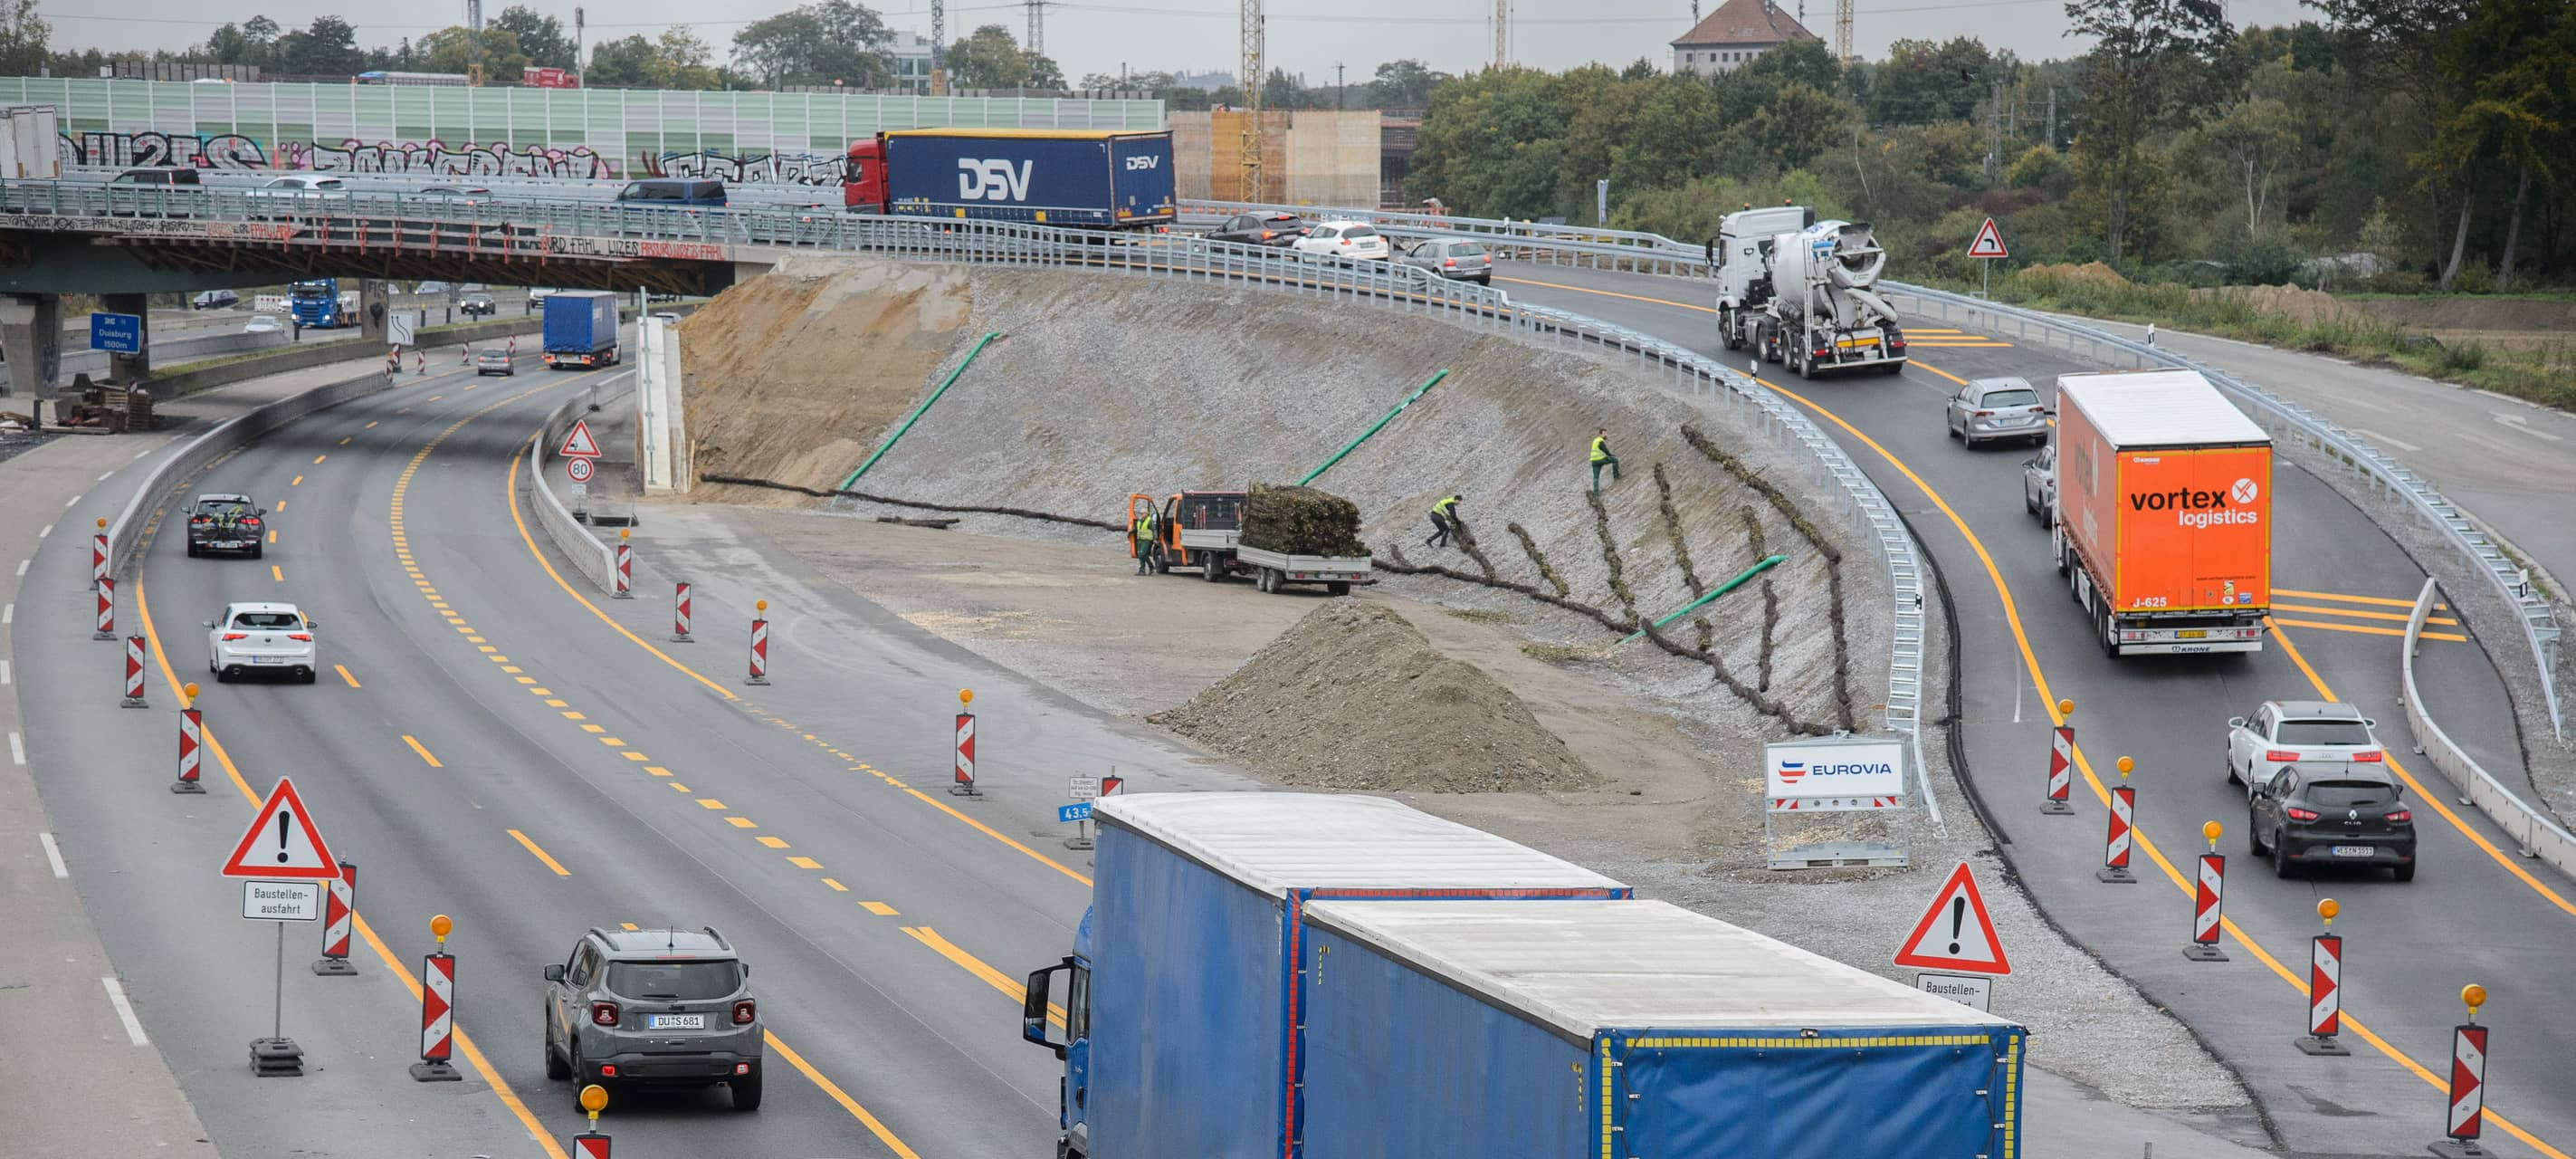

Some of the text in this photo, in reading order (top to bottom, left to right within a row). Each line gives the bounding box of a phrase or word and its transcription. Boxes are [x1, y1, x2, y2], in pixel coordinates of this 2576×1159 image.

[1126, 155, 1159, 170] DSV
[959, 158, 1033, 201] DSV
[608, 239, 639, 255] LUZES
[99, 329, 132, 340] Duisburg
[572, 463, 588, 475] 80
[2131, 487, 2226, 511] vortex
[2179, 509, 2257, 529] logistics
[2132, 597, 2167, 608] J-625
[1813, 763, 1892, 775] EUROVIA
[254, 888, 308, 899] Baustellen-
[261, 904, 301, 914] ausfahrt
[1926, 982, 1980, 996] Baustellen-
[658, 1017, 670, 1026] DU
[682, 1017, 700, 1026] 681
